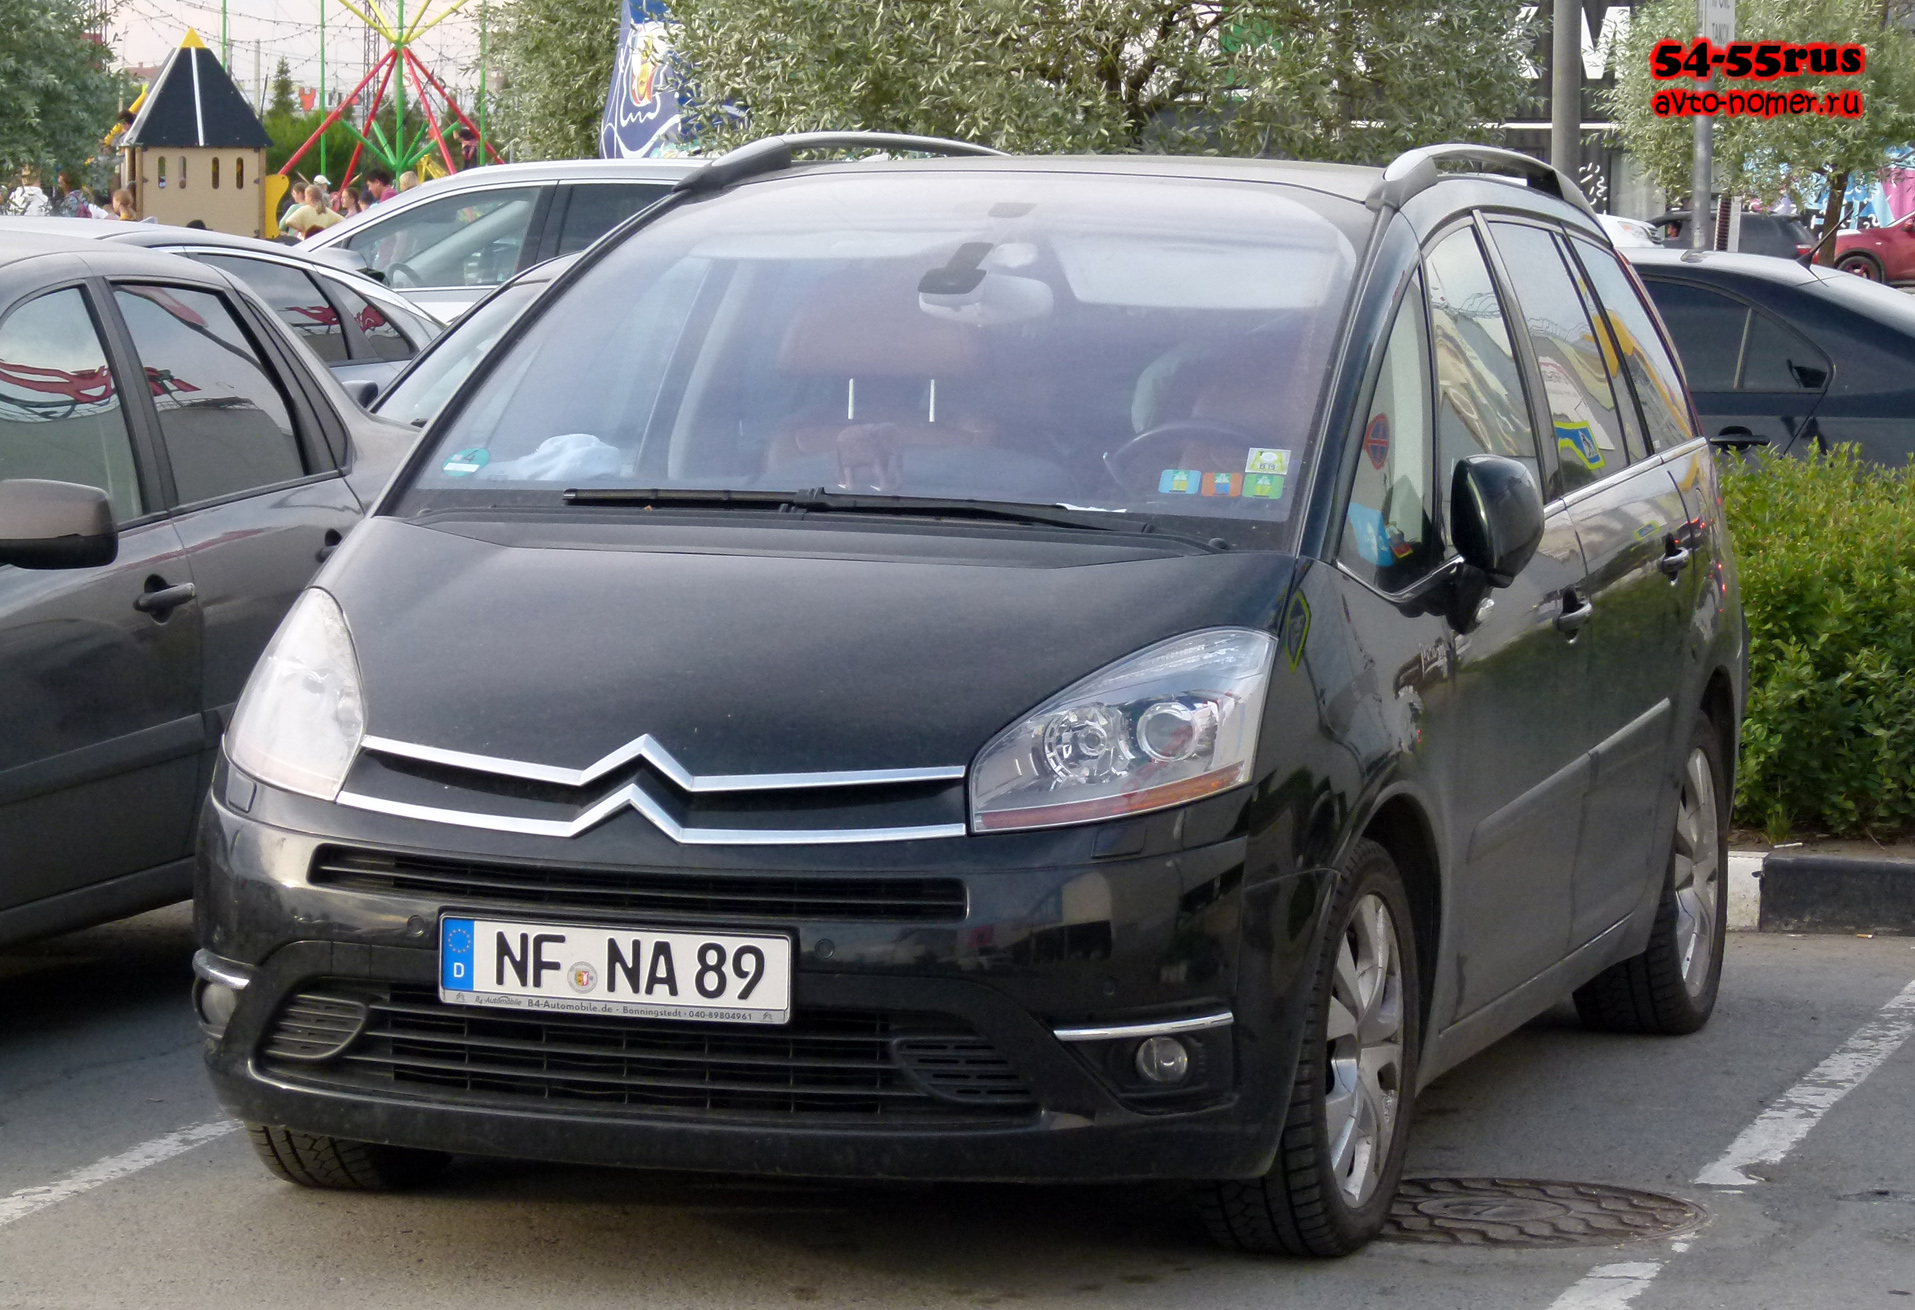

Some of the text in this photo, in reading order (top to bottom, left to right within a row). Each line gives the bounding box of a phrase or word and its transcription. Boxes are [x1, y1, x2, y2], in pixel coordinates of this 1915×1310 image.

[453, 962, 465, 978] D
[496, 930, 566, 988] NF
[607, 937, 678, 997] NA
[694, 942, 765, 1000] 89
[527, 998, 613, 1013] B4-Automobile.de
[688, 1010, 752, 1021] 040-89804961
